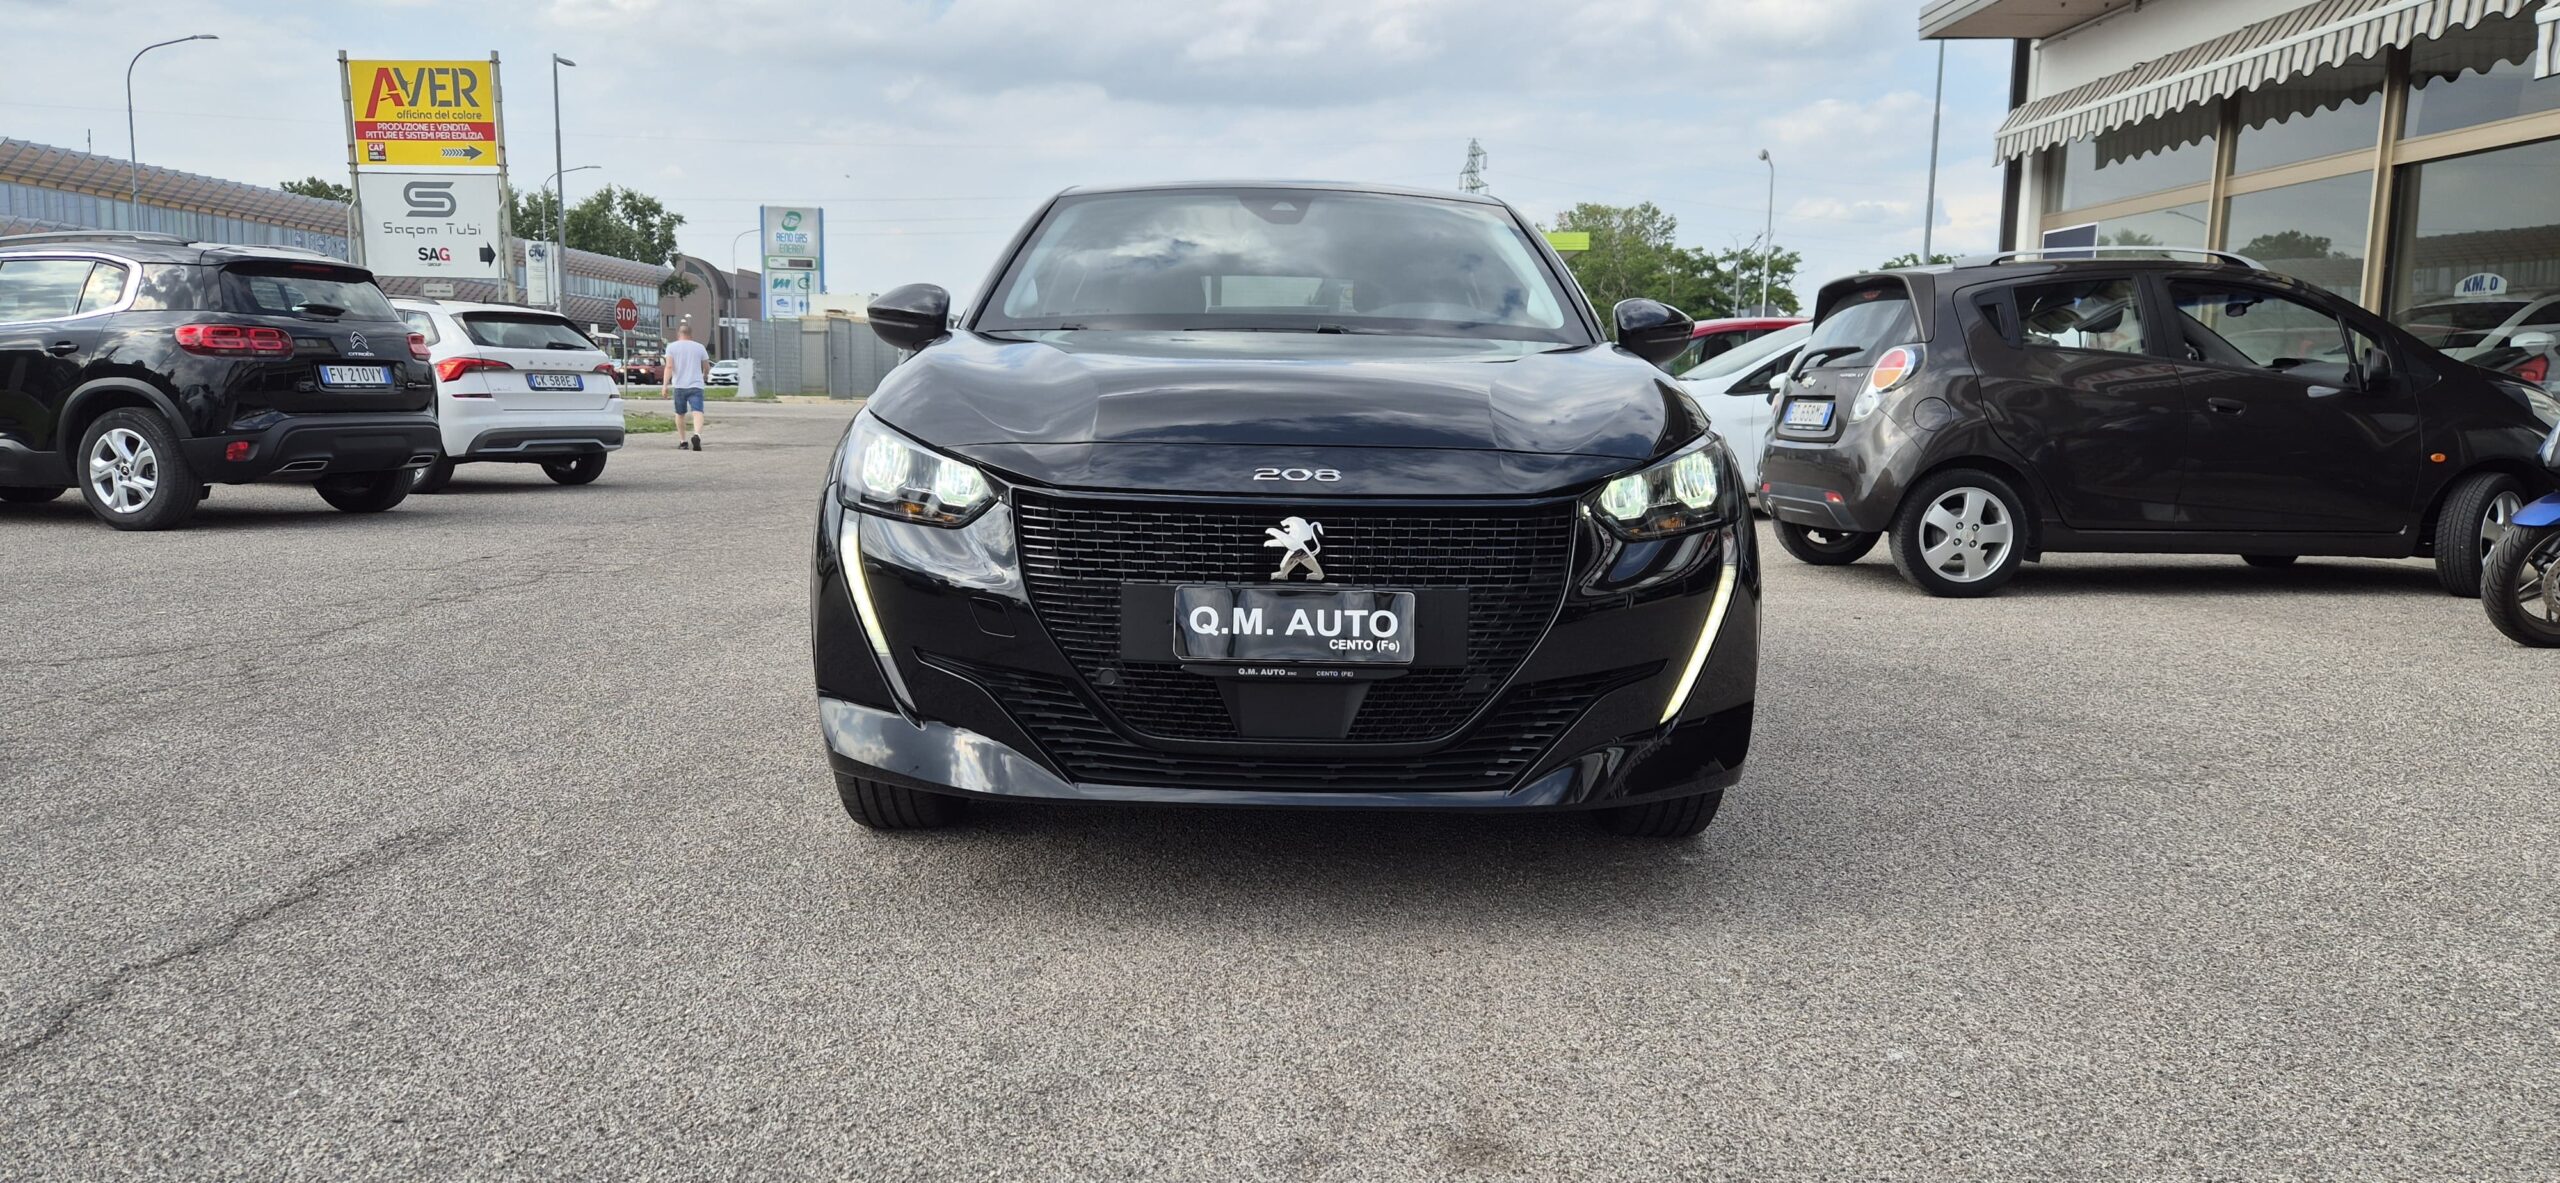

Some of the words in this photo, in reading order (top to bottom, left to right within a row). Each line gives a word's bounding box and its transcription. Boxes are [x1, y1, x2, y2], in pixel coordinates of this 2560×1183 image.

[365, 67, 480, 119] AVER
[397, 110, 433, 119] officina
[435, 111, 450, 119] del
[452, 111, 482, 120] colore
[377, 123, 429, 131] PRODUZIONE
[430, 123, 435, 131] E
[366, 131, 398, 139] PITTURE
[399, 131, 405, 139] E
[406, 131, 435, 139] SISTEMI
[452, 132, 484, 140] EDILIZIA
[446, 223, 481, 235] Tubi
[418, 247, 451, 261] SAG
[616, 308, 637, 321] STOP
[329, 367, 343, 381] FV
[348, 367, 383, 382] 210VY
[1253, 467, 1342, 482] 208
[1189, 606, 1274, 636] Q.M.
[1285, 609, 1399, 637] AUTO
[1329, 639, 1374, 651] CENTO
[1376, 641, 1400, 653] (Fe)
[1238, 668, 1258, 676] Q.M.
